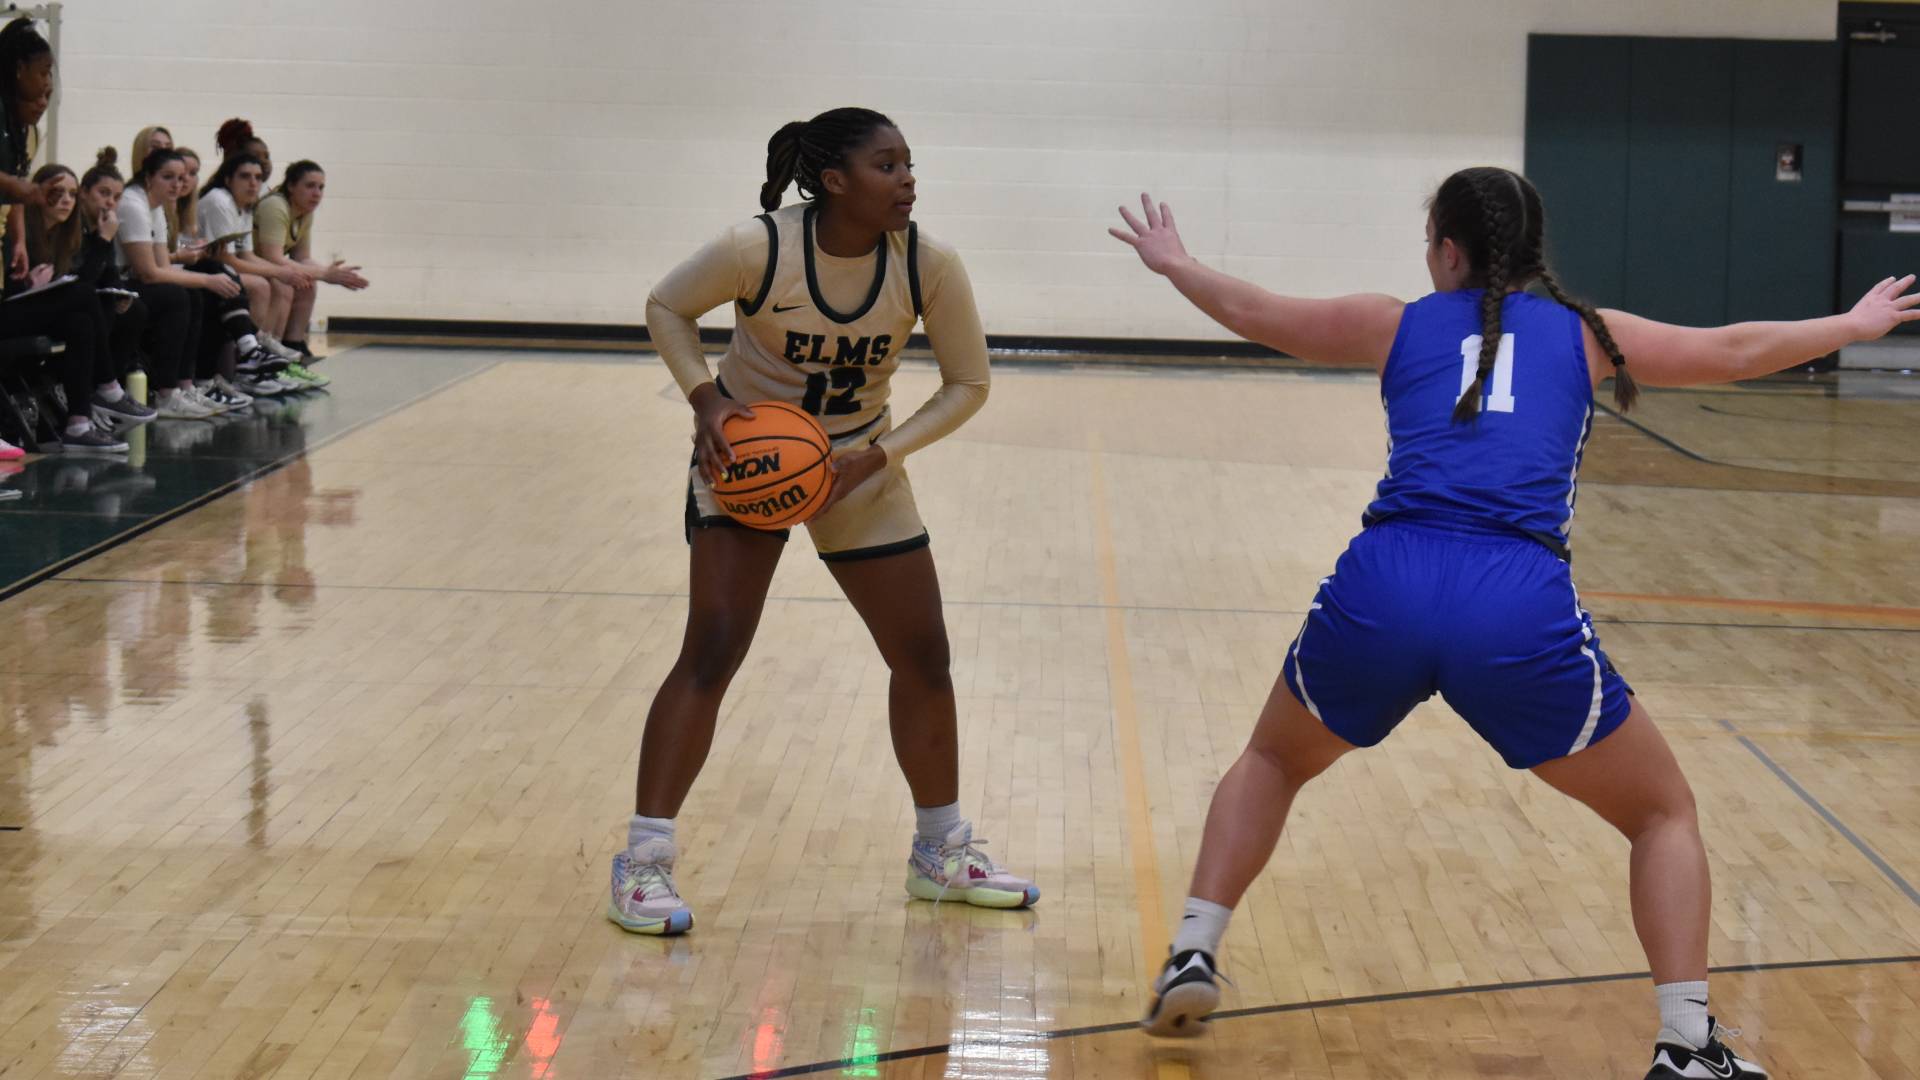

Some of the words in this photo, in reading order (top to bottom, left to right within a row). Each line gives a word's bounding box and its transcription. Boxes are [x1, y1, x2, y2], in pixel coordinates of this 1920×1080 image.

[784, 330, 892, 366] ELMS
[802, 367, 866, 415] 12
[1455, 333, 1515, 413] 11
[720, 485, 808, 517] Wilson
